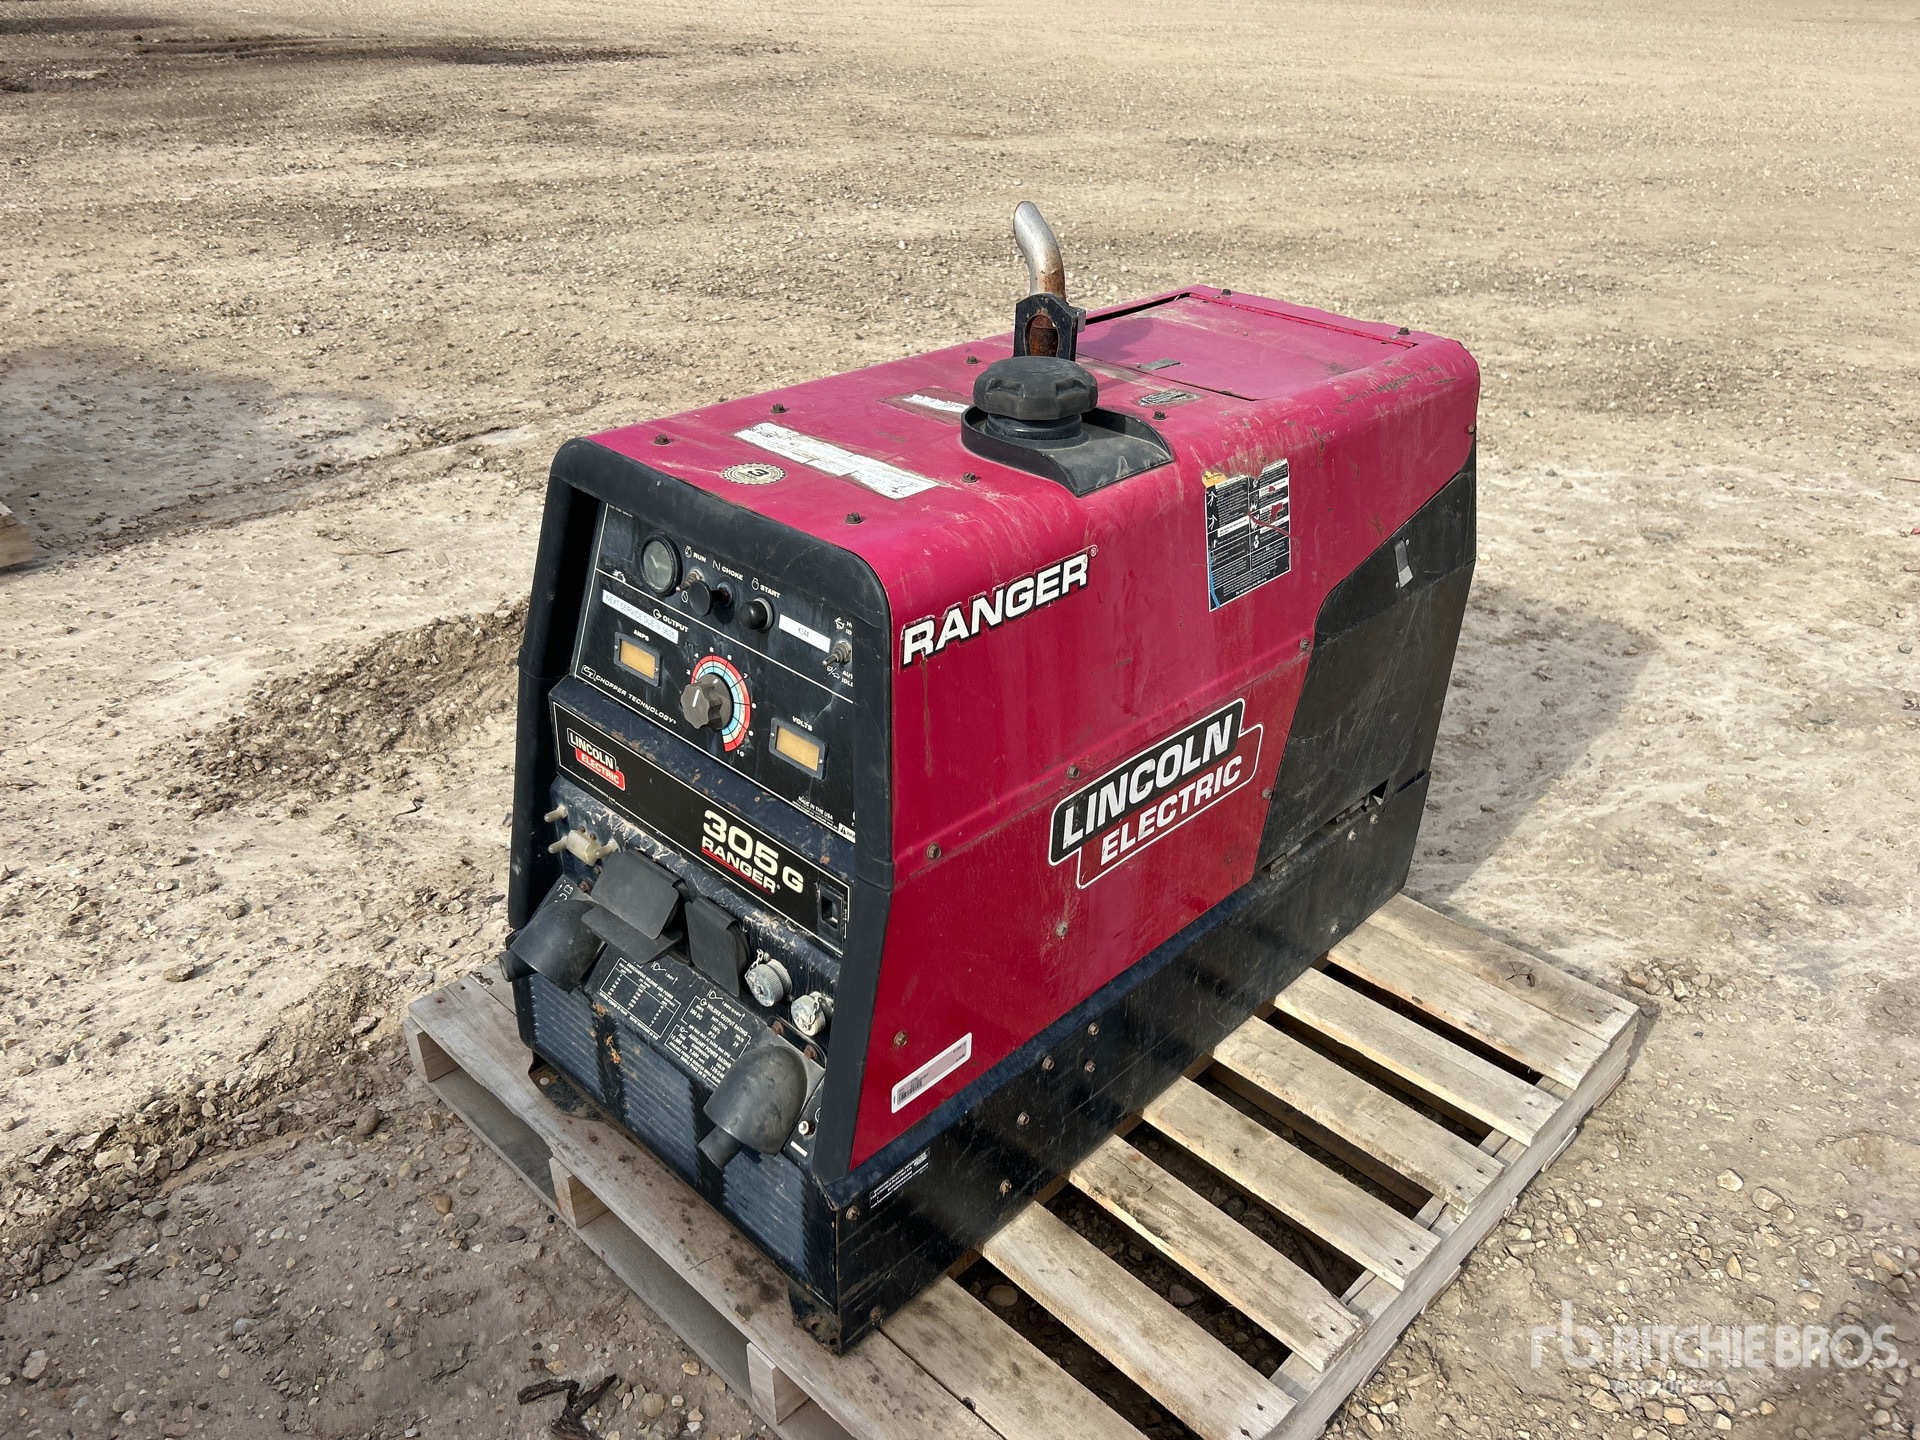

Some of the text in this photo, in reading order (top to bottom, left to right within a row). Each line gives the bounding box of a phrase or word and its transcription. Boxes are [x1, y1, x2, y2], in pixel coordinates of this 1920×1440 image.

[693, 552, 707, 563] RUN
[721, 566, 744, 581] CHOKE
[760, 584, 781, 599] START
[606, 594, 620, 608] NEXT
[620, 602, 644, 621] SERVICE
[644, 615, 655, 628] DUE
[662, 615, 689, 633] OUTPUT
[903, 553, 1089, 665] RANGER
[633, 629, 650, 642] AMPS
[595, 674, 627, 696] CHOPPER
[792, 715, 813, 731] VOLTS
[569, 732, 614, 770] LINCOLN
[581, 753, 620, 785] ELECTRIC
[1062, 713, 1234, 850] LINCOLN
[1100, 755, 1243, 867] ELECTRIC
[701, 835, 776, 894] RANGER
[703, 809, 779, 876] 305
[782, 865, 805, 894] G
